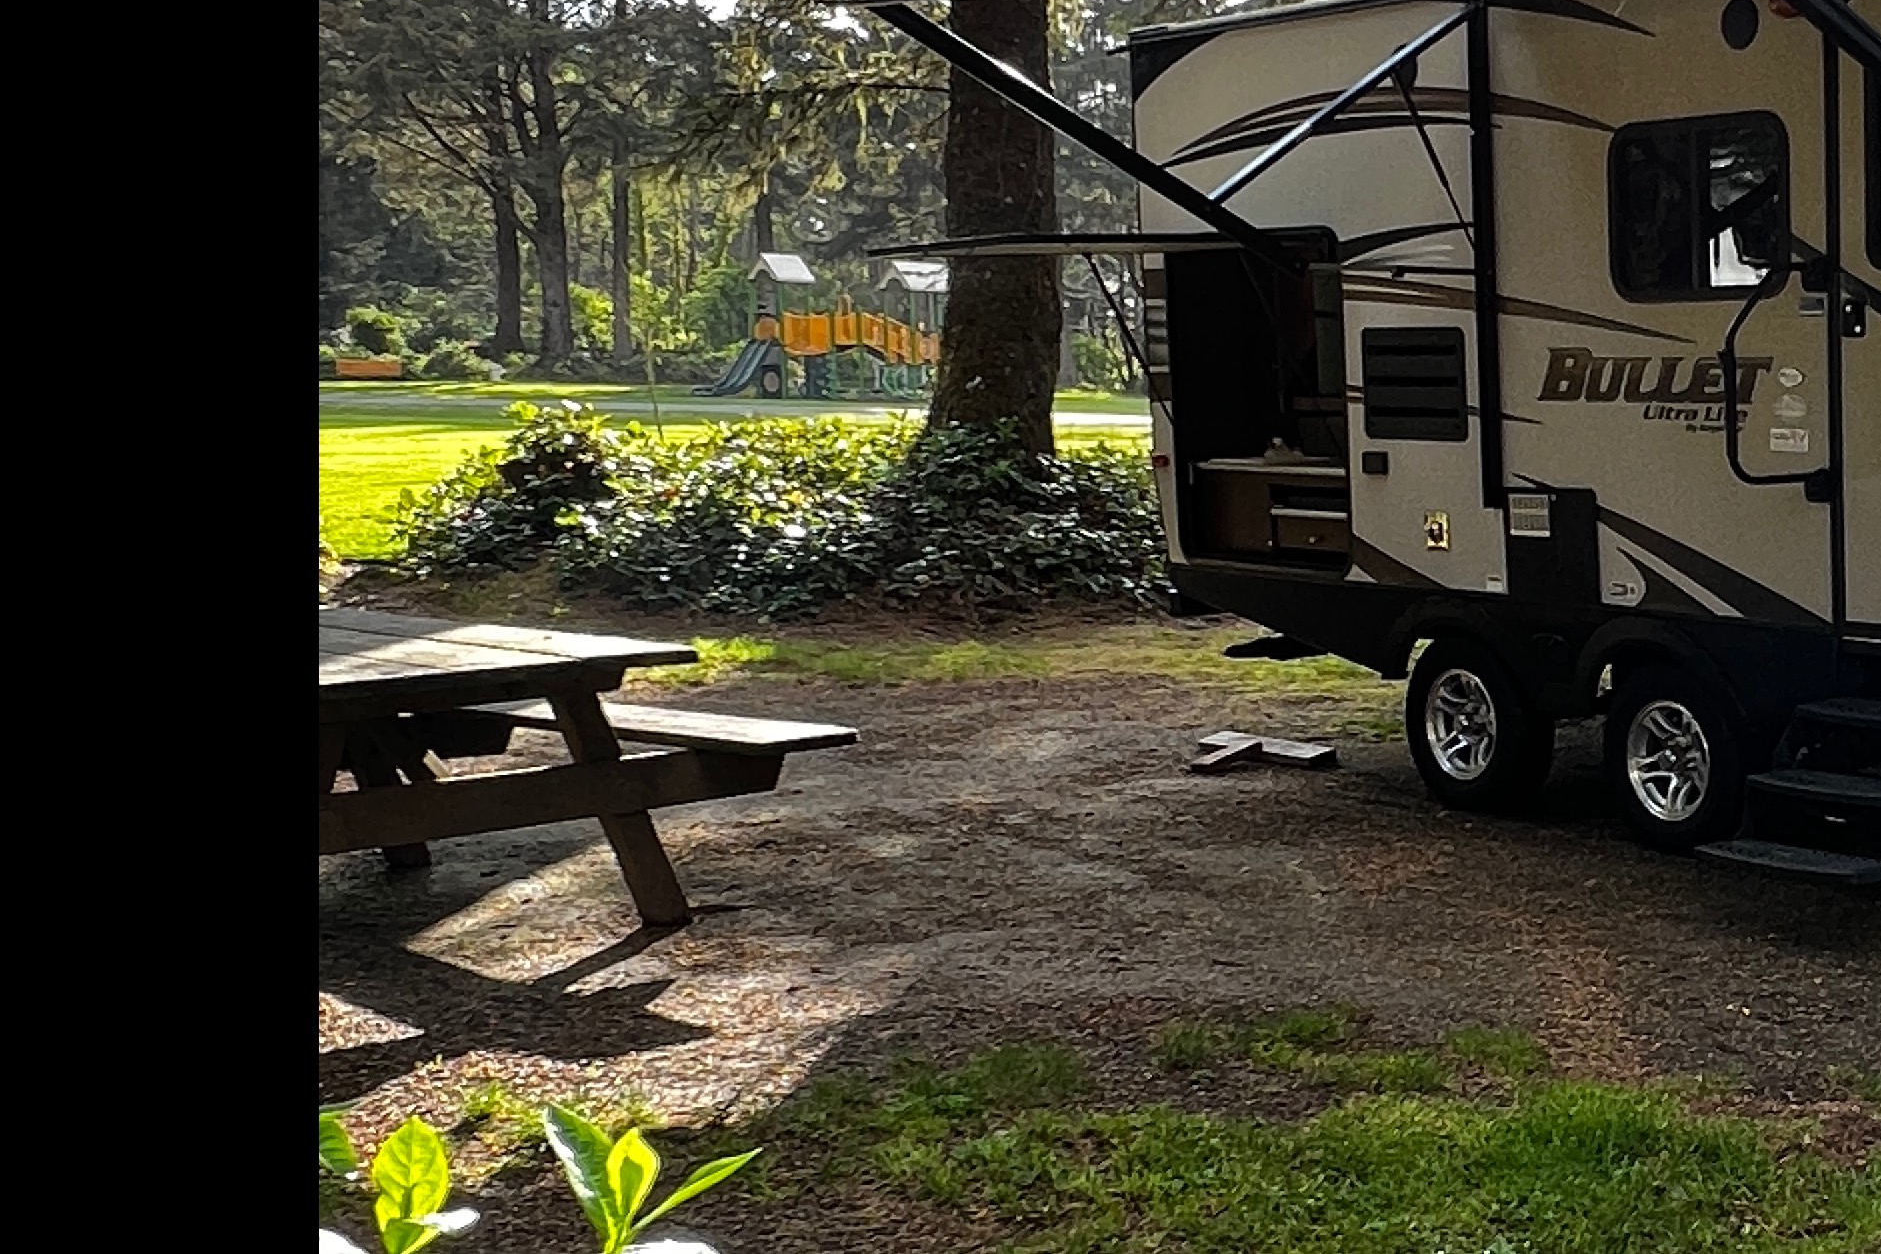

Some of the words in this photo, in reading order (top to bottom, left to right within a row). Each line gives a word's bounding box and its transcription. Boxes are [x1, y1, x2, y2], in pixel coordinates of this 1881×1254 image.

[1537, 347, 1775, 405] BULLET
[1643, 404, 1699, 420] Ultra
[1703, 406, 1749, 423] Lie
